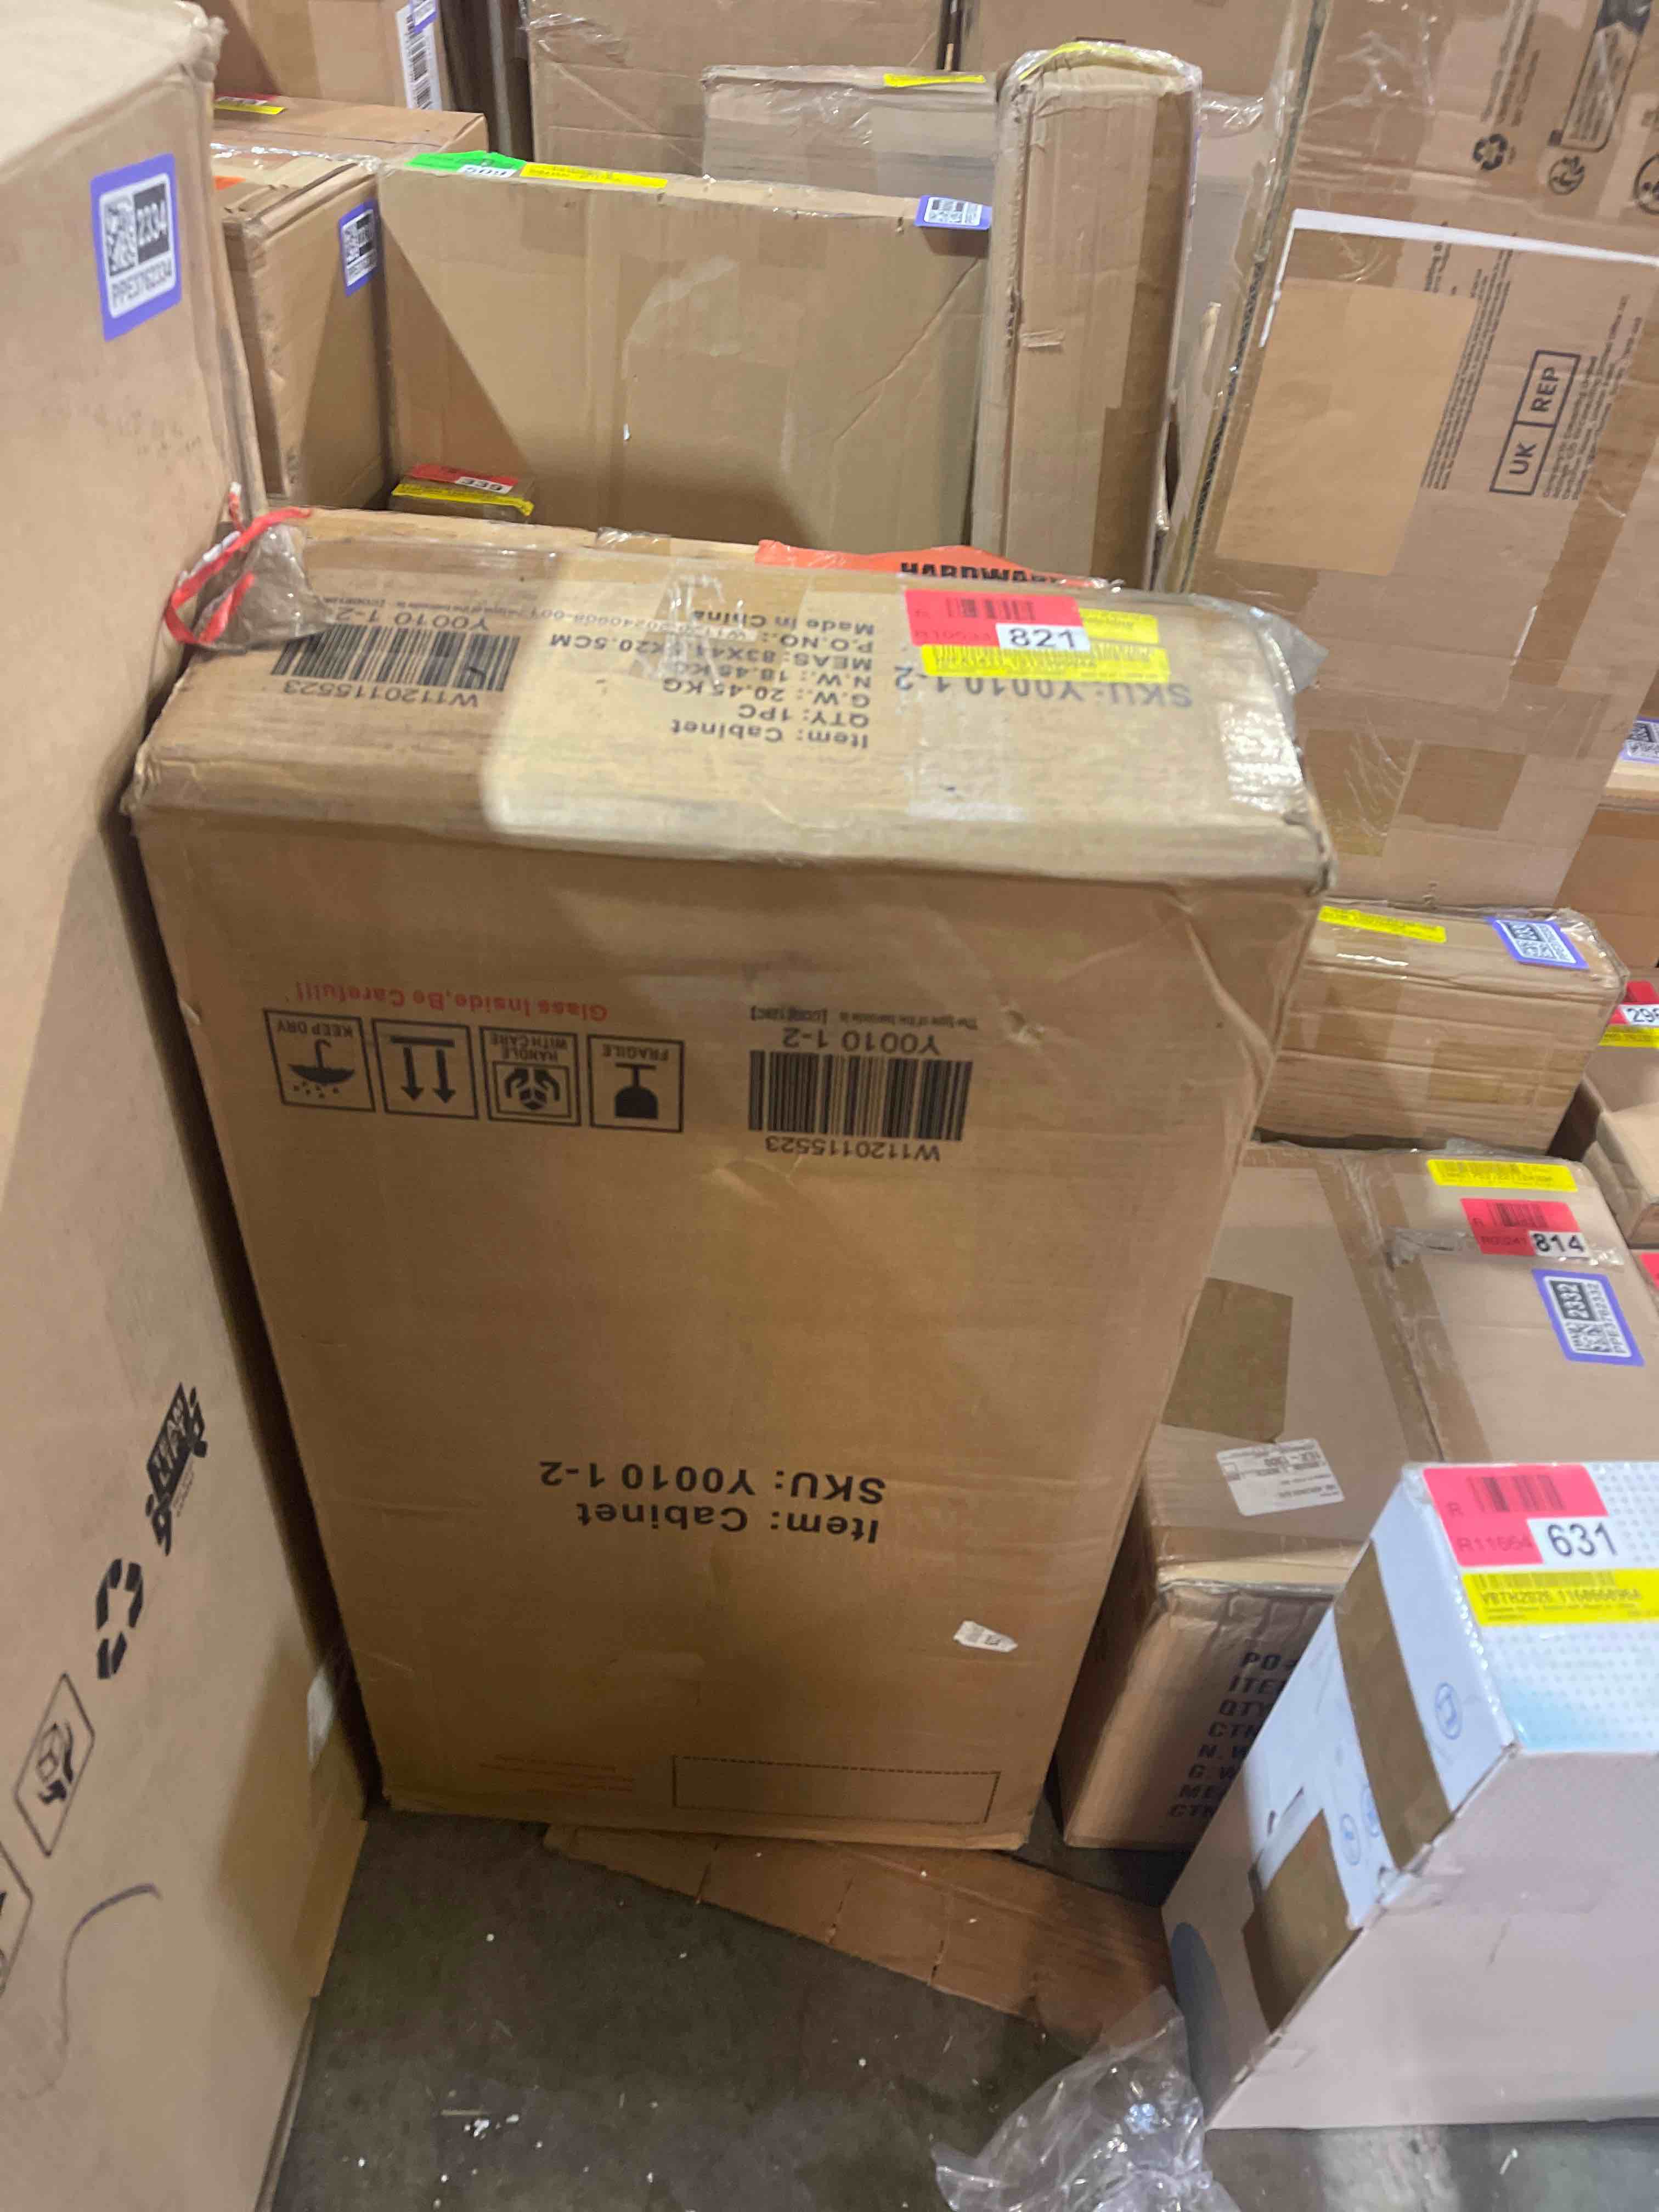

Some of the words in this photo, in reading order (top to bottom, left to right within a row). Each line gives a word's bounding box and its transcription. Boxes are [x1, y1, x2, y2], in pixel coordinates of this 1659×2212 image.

[1530, 366, 1560, 413] REP
[1509, 441, 1536, 476] UK
[901, 562, 1058, 583] HARDWA
[334, 607, 379, 622] 1-2
[393, 612, 490, 631] Y0010
[692, 609, 767, 627] China
[774, 615, 798, 629] in
[805, 618, 875, 636] Made
[1009, 628, 1076, 649] 821
[783, 651, 873, 670] MEAS:
[662, 678, 704, 695] KG
[802, 670, 872, 688] N.W.:
[281, 679, 479, 708] W1120115523
[711, 682, 786, 702] 20.45
[797, 687, 870, 709] G.W.:
[738, 703, 791, 722] 1PC
[803, 713, 870, 730] QTY:
[671, 719, 783, 743] Cabinet
[798, 728, 868, 748] Item:
[536, 1000, 608, 1022] Glass
[276, 1019, 308, 1036] DRY
[313, 1023, 353, 1038] KEEP
[782, 1027, 830, 1048] 1-2
[600, 1043, 670, 1062] FRAGILE
[841, 1030, 942, 1056] Y0010
[501, 1047, 558, 1062] HANDLE
[765, 1135, 941, 1162] W1120115523
[1532, 1233, 1585, 1252] 814
[540, 1461, 605, 1488] 1-2
[622, 1463, 755, 1496] Y0010
[775, 1470, 885, 1505] SKU:
[577, 1502, 748, 1533] Cabinet
[770, 1511, 879, 1544] Item:
[1547, 1522, 1618, 1557] 631
